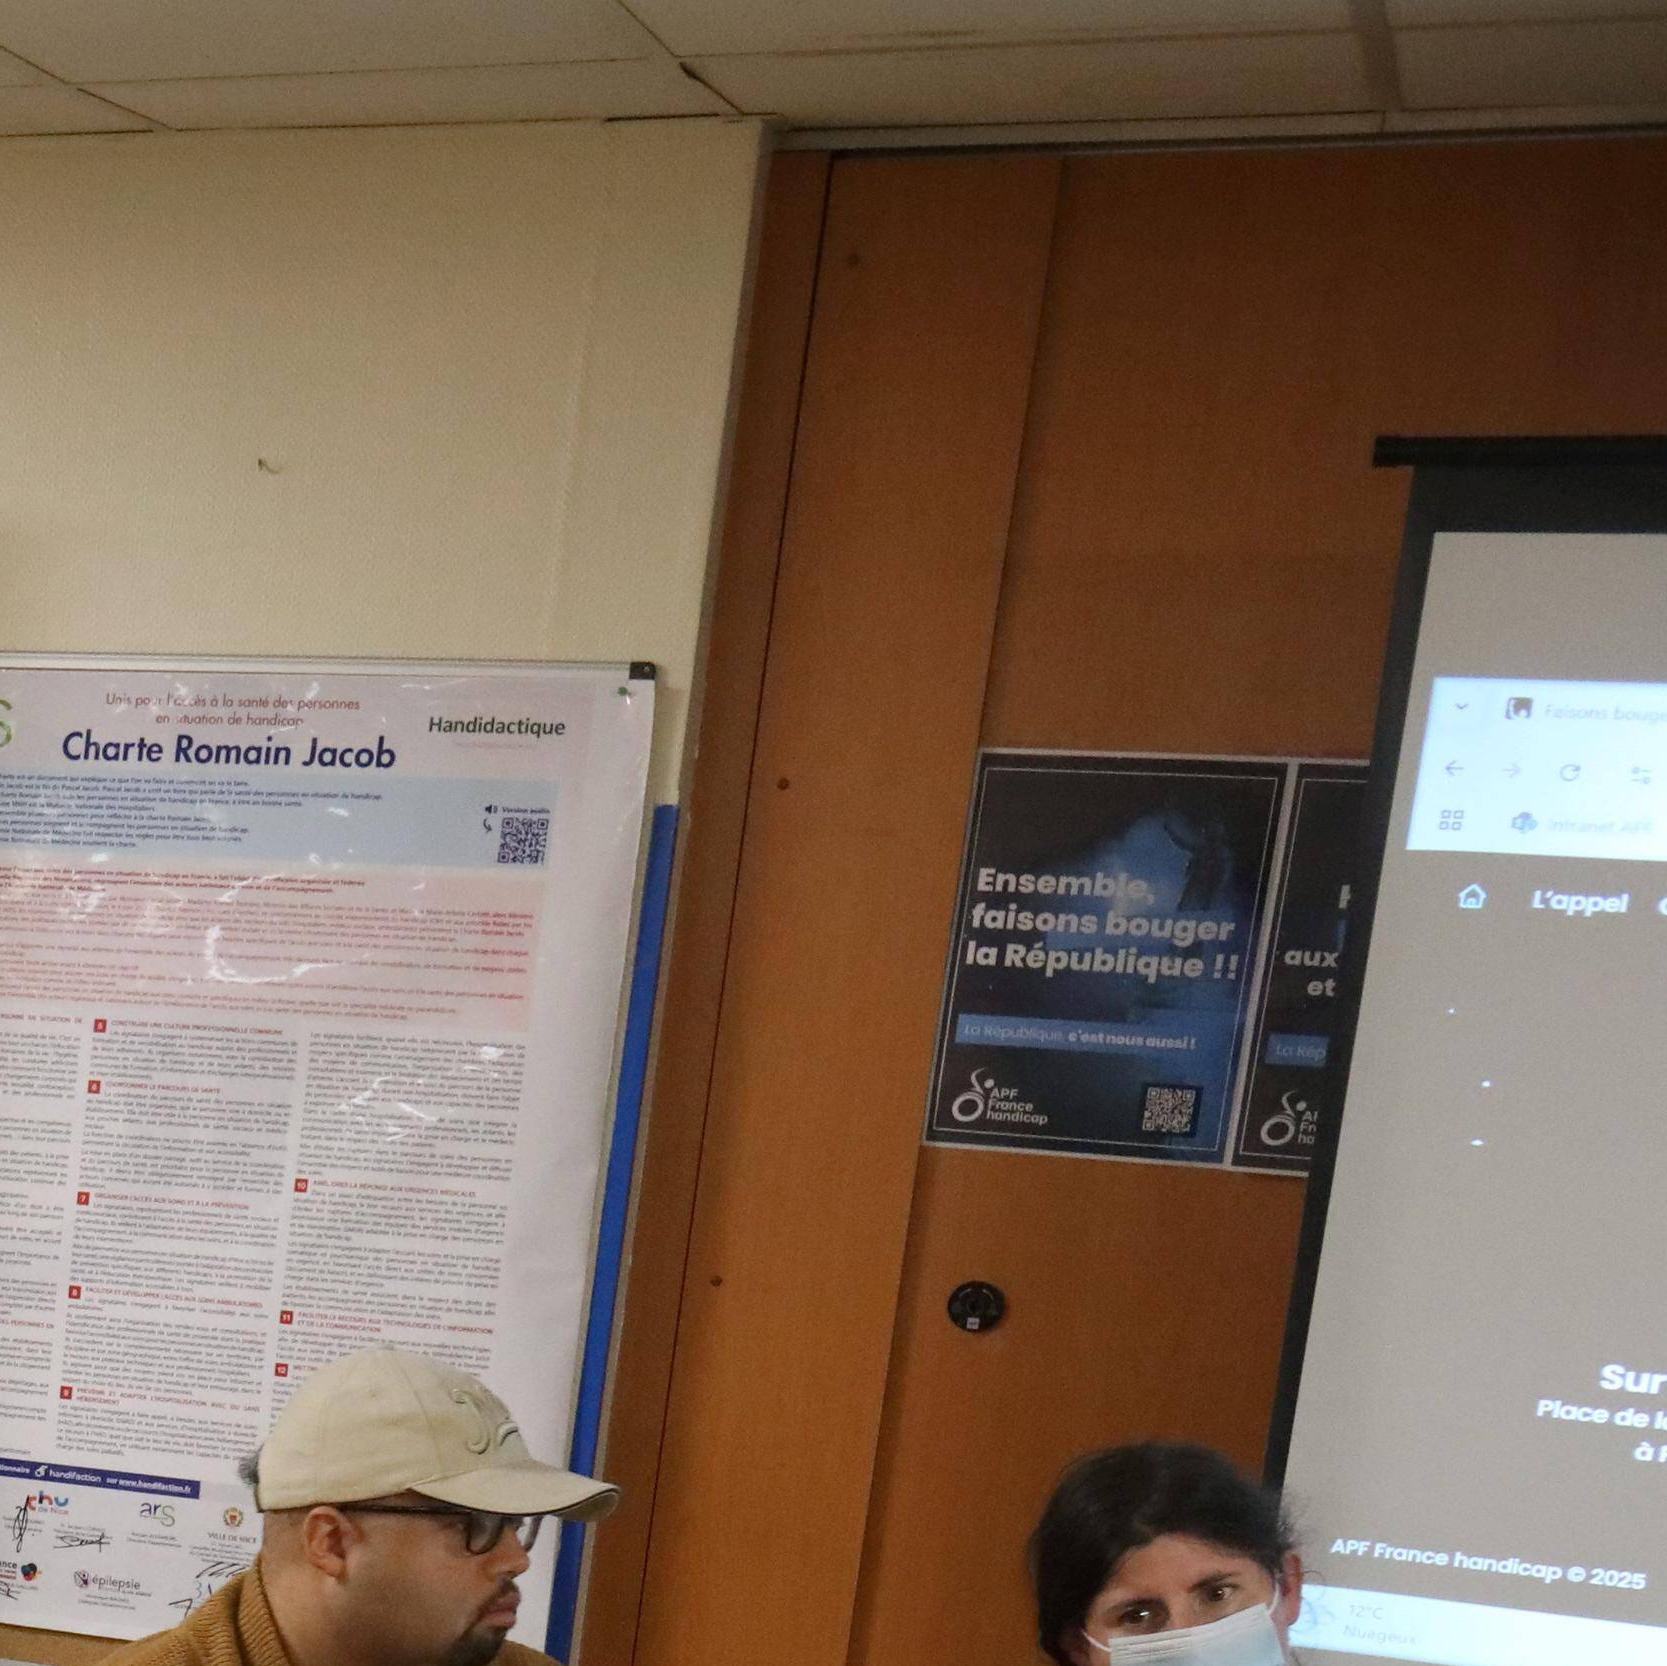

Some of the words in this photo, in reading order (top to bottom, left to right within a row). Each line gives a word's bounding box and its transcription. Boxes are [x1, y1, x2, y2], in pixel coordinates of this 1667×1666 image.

[210, 695, 218, 706] à
[223, 694, 234, 707] la
[238, 694, 270, 708] santé
[297, 698, 361, 711] personnes
[155, 714, 170, 724] en
[176, 712, 224, 725] tuation
[227, 713, 243, 726] de
[428, 716, 566, 736] Handidactique
[62, 729, 164, 763] Charte
[174, 734, 291, 766] Romain
[302, 736, 396, 769] Jacob
[977, 867, 1156, 906] Ensemble,
[1531, 890, 1630, 917] L'appel
[971, 902, 1098, 934] faisons
[1105, 910, 1237, 948] bouger
[966, 940, 998, 966] la
[1004, 942, 1205, 984] République
[1213, 954, 1239, 980] !!
[1284, 950, 1339, 969] aux
[1306, 977, 1337, 997] et
[1105, 1033, 1144, 1046] nous
[1145, 1036, 1189, 1049] aussi
[990, 1088, 1019, 1100] APF
[988, 1099, 1034, 1111] France
[986, 1110, 1048, 1127] handicap
[1599, 1364, 1667, 1395] Sur
[1536, 1399, 1609, 1424] Place
[1614, 1407, 1650, 1428] de
[49, 1468, 103, 1484] handifaction
[1330, 1538, 1371, 1556] APF
[1373, 1542, 1449, 1566] France
[1453, 1551, 1563, 1584] handicap
[1588, 1568, 1647, 1591] 2025
[92, 1575, 141, 1592] épilepsie
